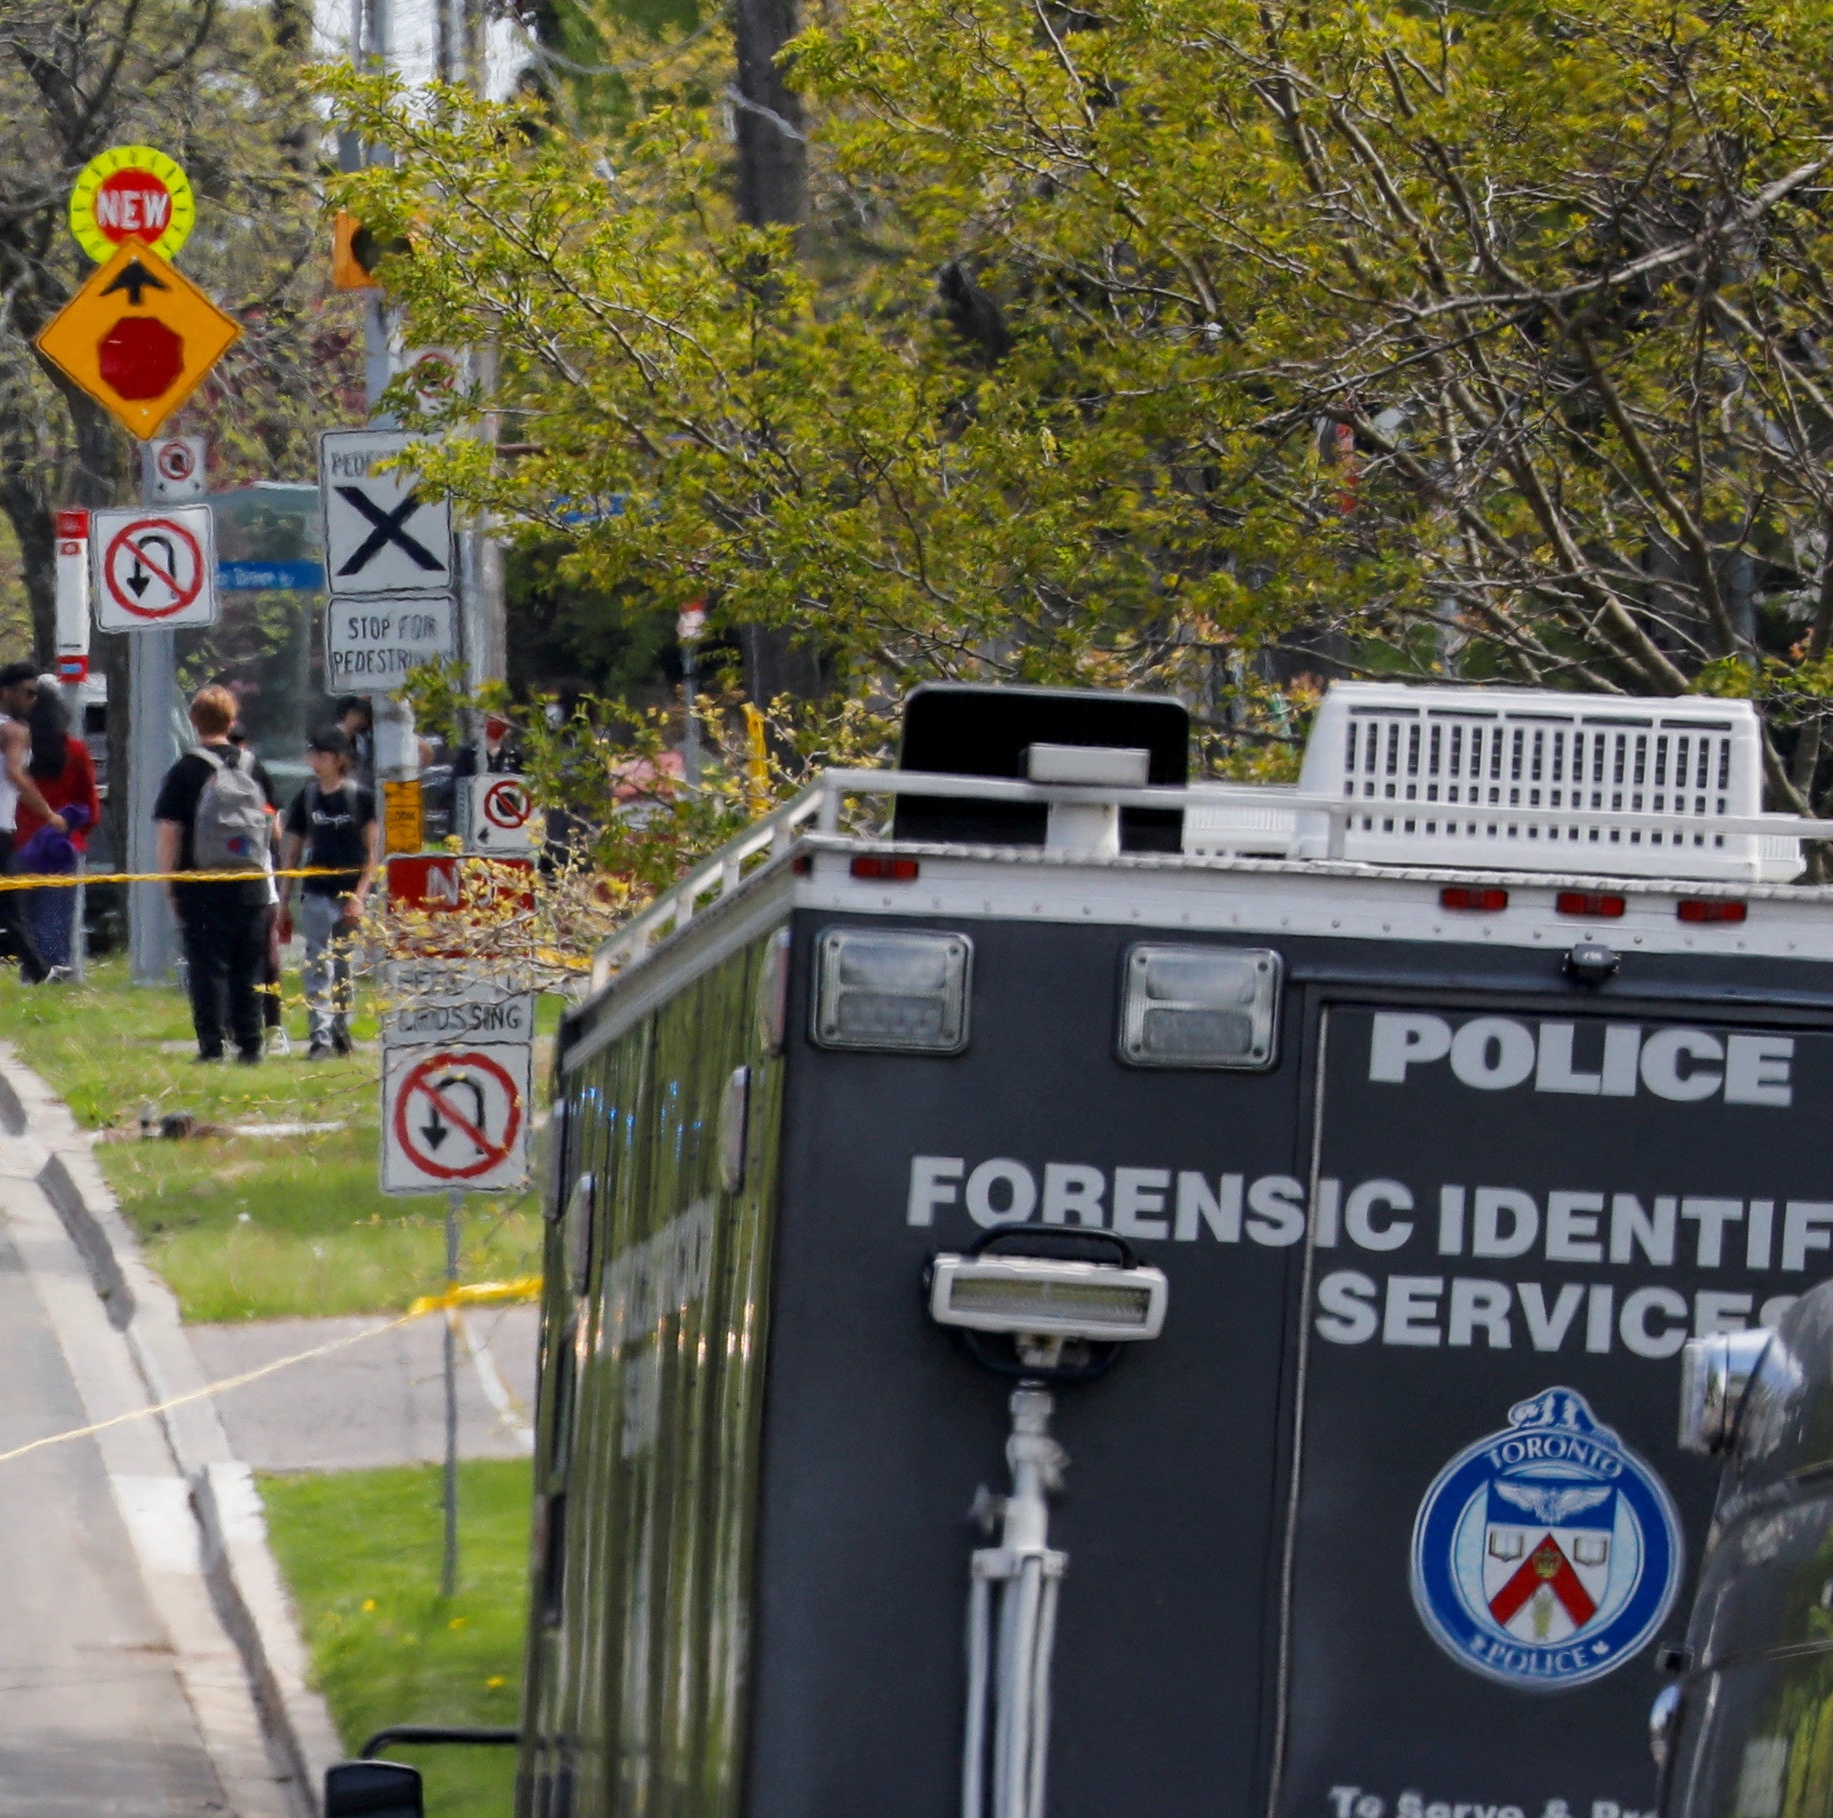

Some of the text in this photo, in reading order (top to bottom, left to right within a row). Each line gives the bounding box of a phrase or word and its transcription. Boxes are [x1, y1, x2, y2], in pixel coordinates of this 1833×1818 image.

[97, 189, 169, 230] NEW
[348, 614, 437, 640] STOP FOR
[333, 648, 453, 674] PEDESTRIS
[1370, 1017, 1794, 1106] POLICE
[906, 1157, 1415, 1252] FORENSIC
[1486, 1436, 1622, 1480] TORONTO
[1490, 1644, 1589, 1674] POLICE
